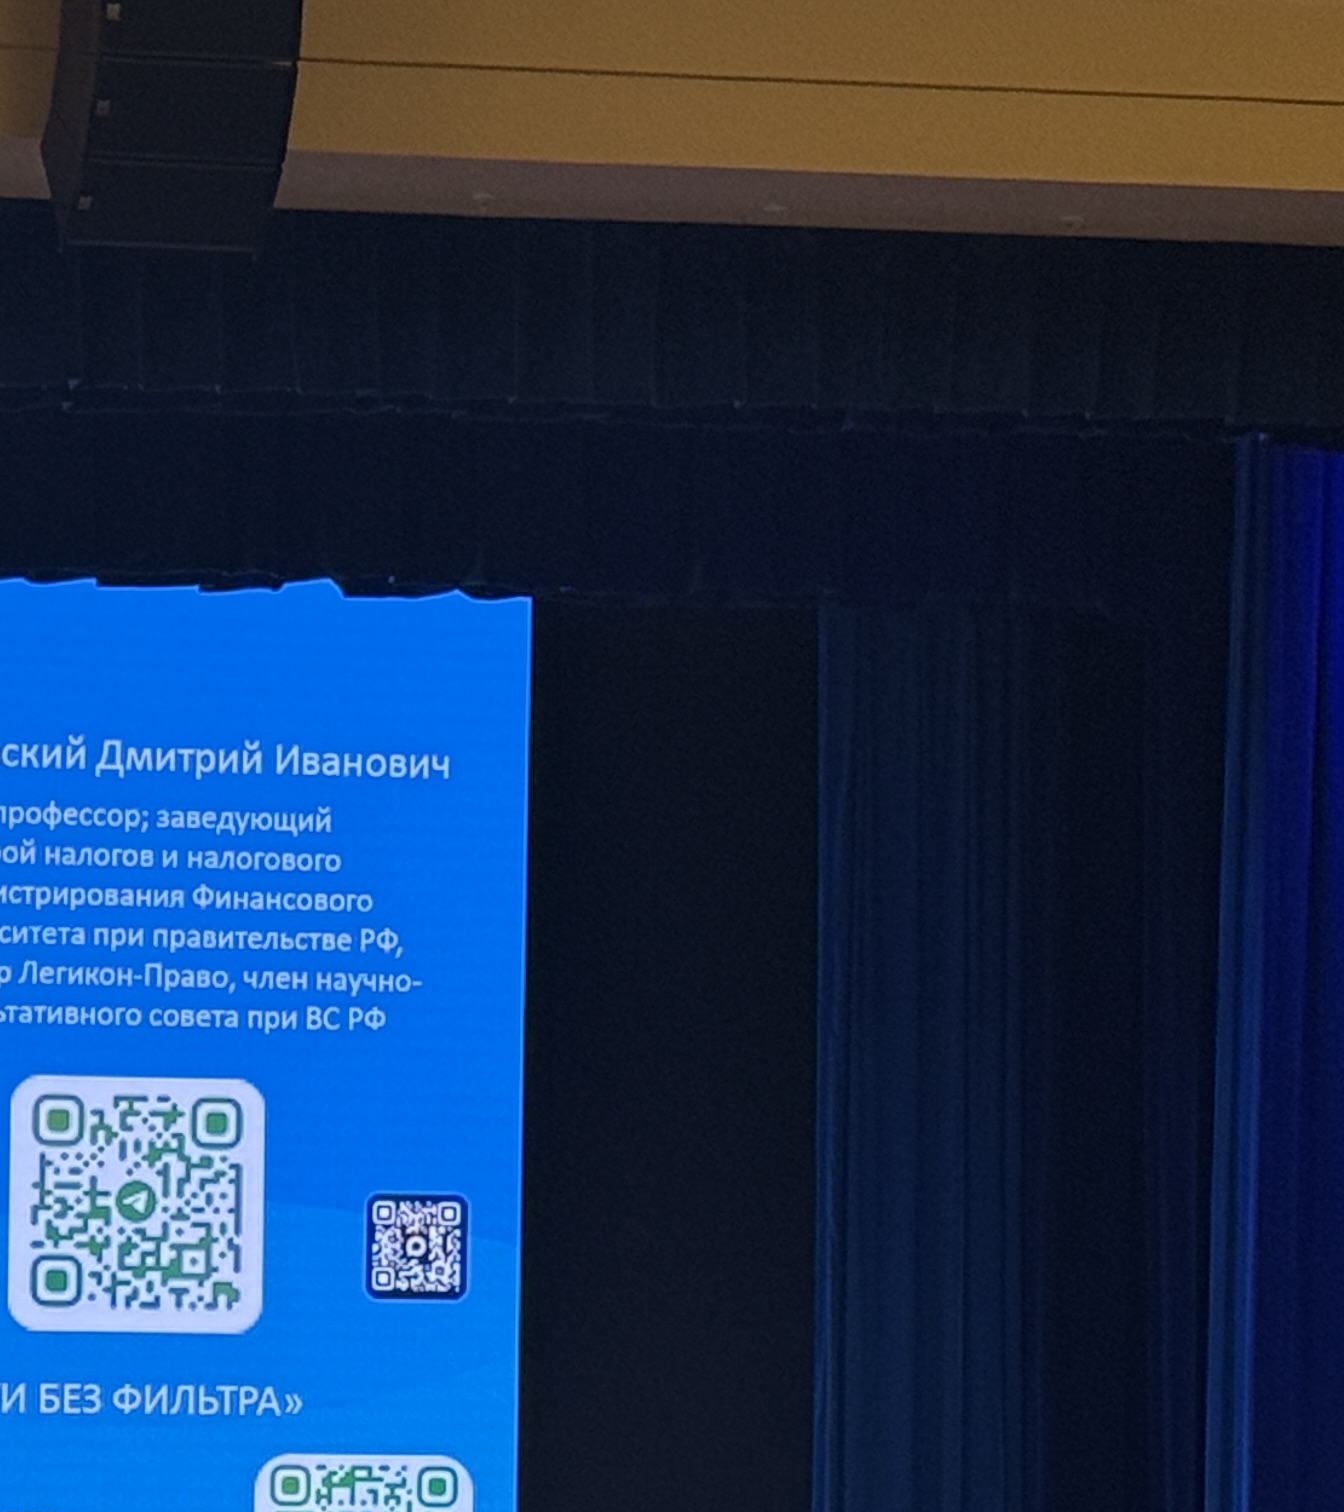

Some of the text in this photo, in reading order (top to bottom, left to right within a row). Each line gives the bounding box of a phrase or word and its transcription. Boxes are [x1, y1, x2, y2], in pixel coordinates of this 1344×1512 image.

[94, 738, 264, 781] Дмитрий
[275, 742, 451, 780] Иванович
[155, 805, 333, 839] заведующий
[44, 845, 154, 868] налогов
[162, 849, 178, 869] и
[187, 850, 342, 872] налогового
[192, 883, 374, 913] Финансового
[93, 927, 144, 952] при
[152, 928, 353, 954] правительстве
[360, 927, 403, 958] РФ,
[16, 959, 237, 995] Легикон-Право,
[243, 970, 308, 990] член
[316, 971, 423, 997] научно-
[149, 1008, 239, 1028] совета
[247, 1010, 298, 1035] при
[306, 1005, 341, 1031] ВС
[348, 1006, 386, 1031] РФ
[39, 1383, 102, 1414] БЕЗ
[111, 1382, 304, 1418] ФИЛЬТРА»
